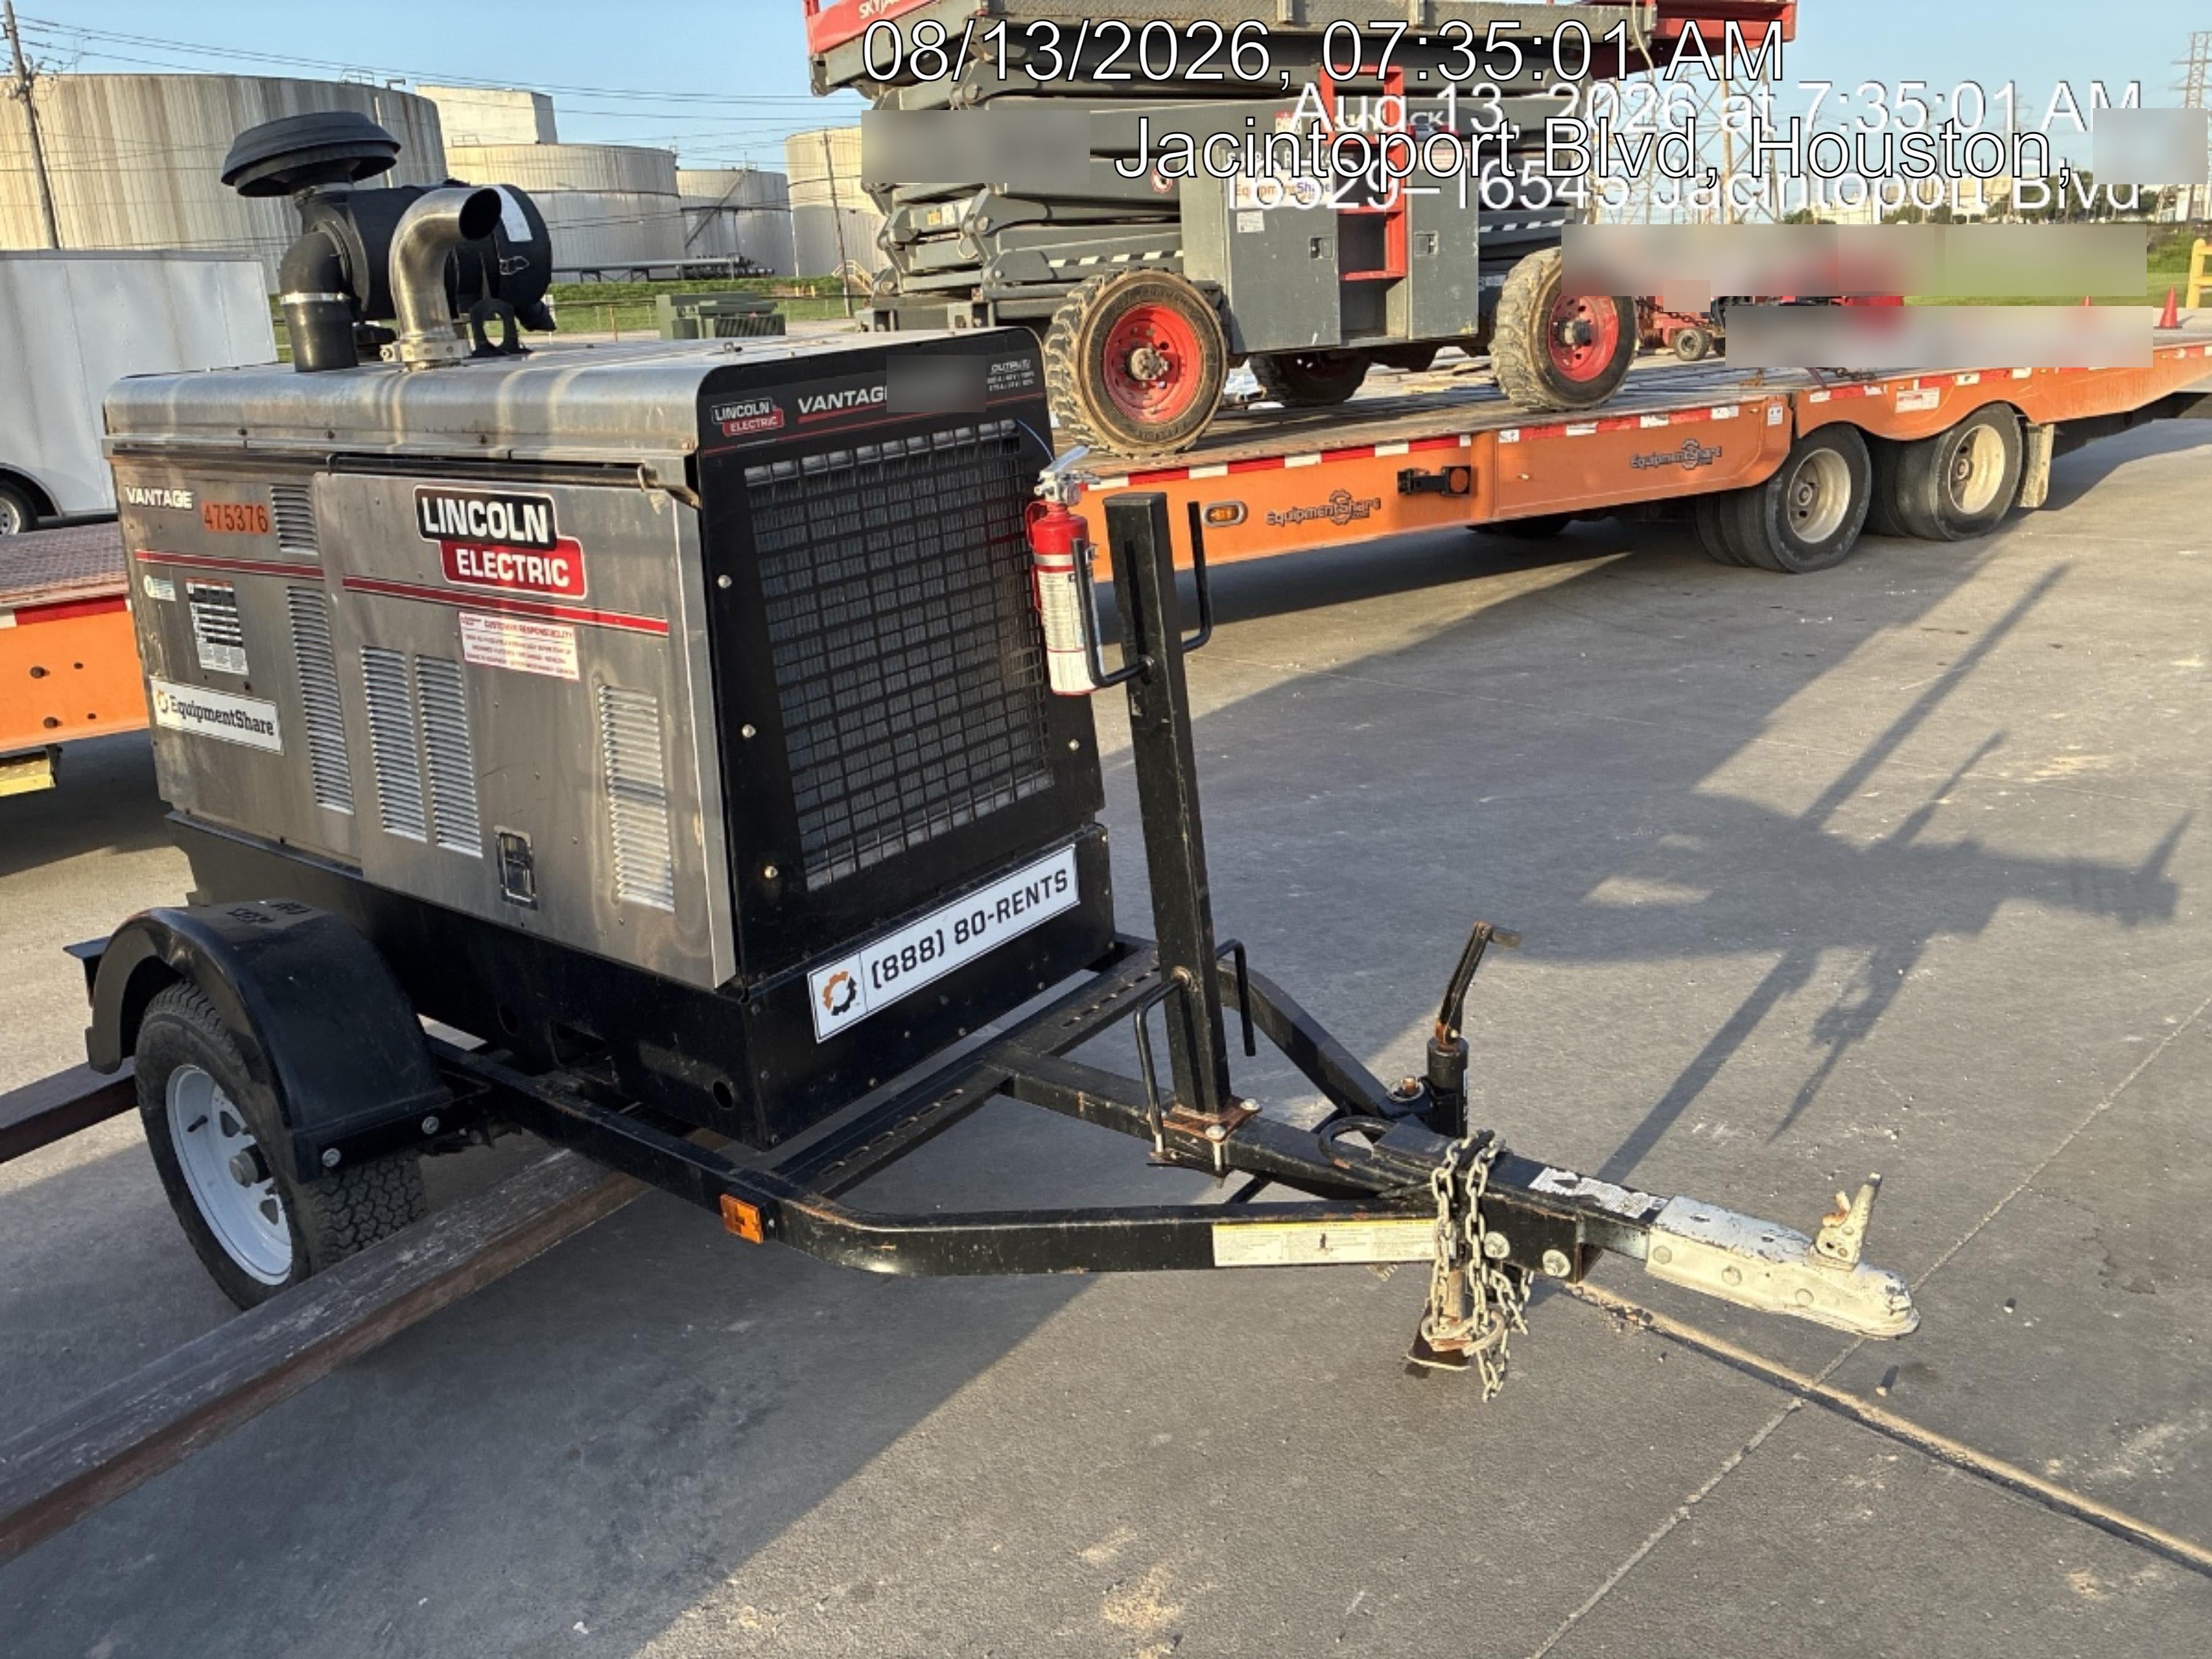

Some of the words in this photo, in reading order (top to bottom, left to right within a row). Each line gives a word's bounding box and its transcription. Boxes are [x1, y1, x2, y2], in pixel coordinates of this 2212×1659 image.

[714, 400, 770, 421] LINCOLN
[798, 385, 887, 414] VANTAG
[729, 416, 778, 433] ELECTRIC
[125, 485, 194, 509] VANTAGE
[203, 504, 269, 533] 475376
[421, 496, 549, 544] LINCOLN
[1266, 497, 1381, 527] EquipmentShare
[455, 548, 571, 587] ELECTRIC
[169, 694, 275, 737] EquipmentShare
[871, 928, 945, 989] (888)
[954, 869, 1068, 945] 80-RENTS
